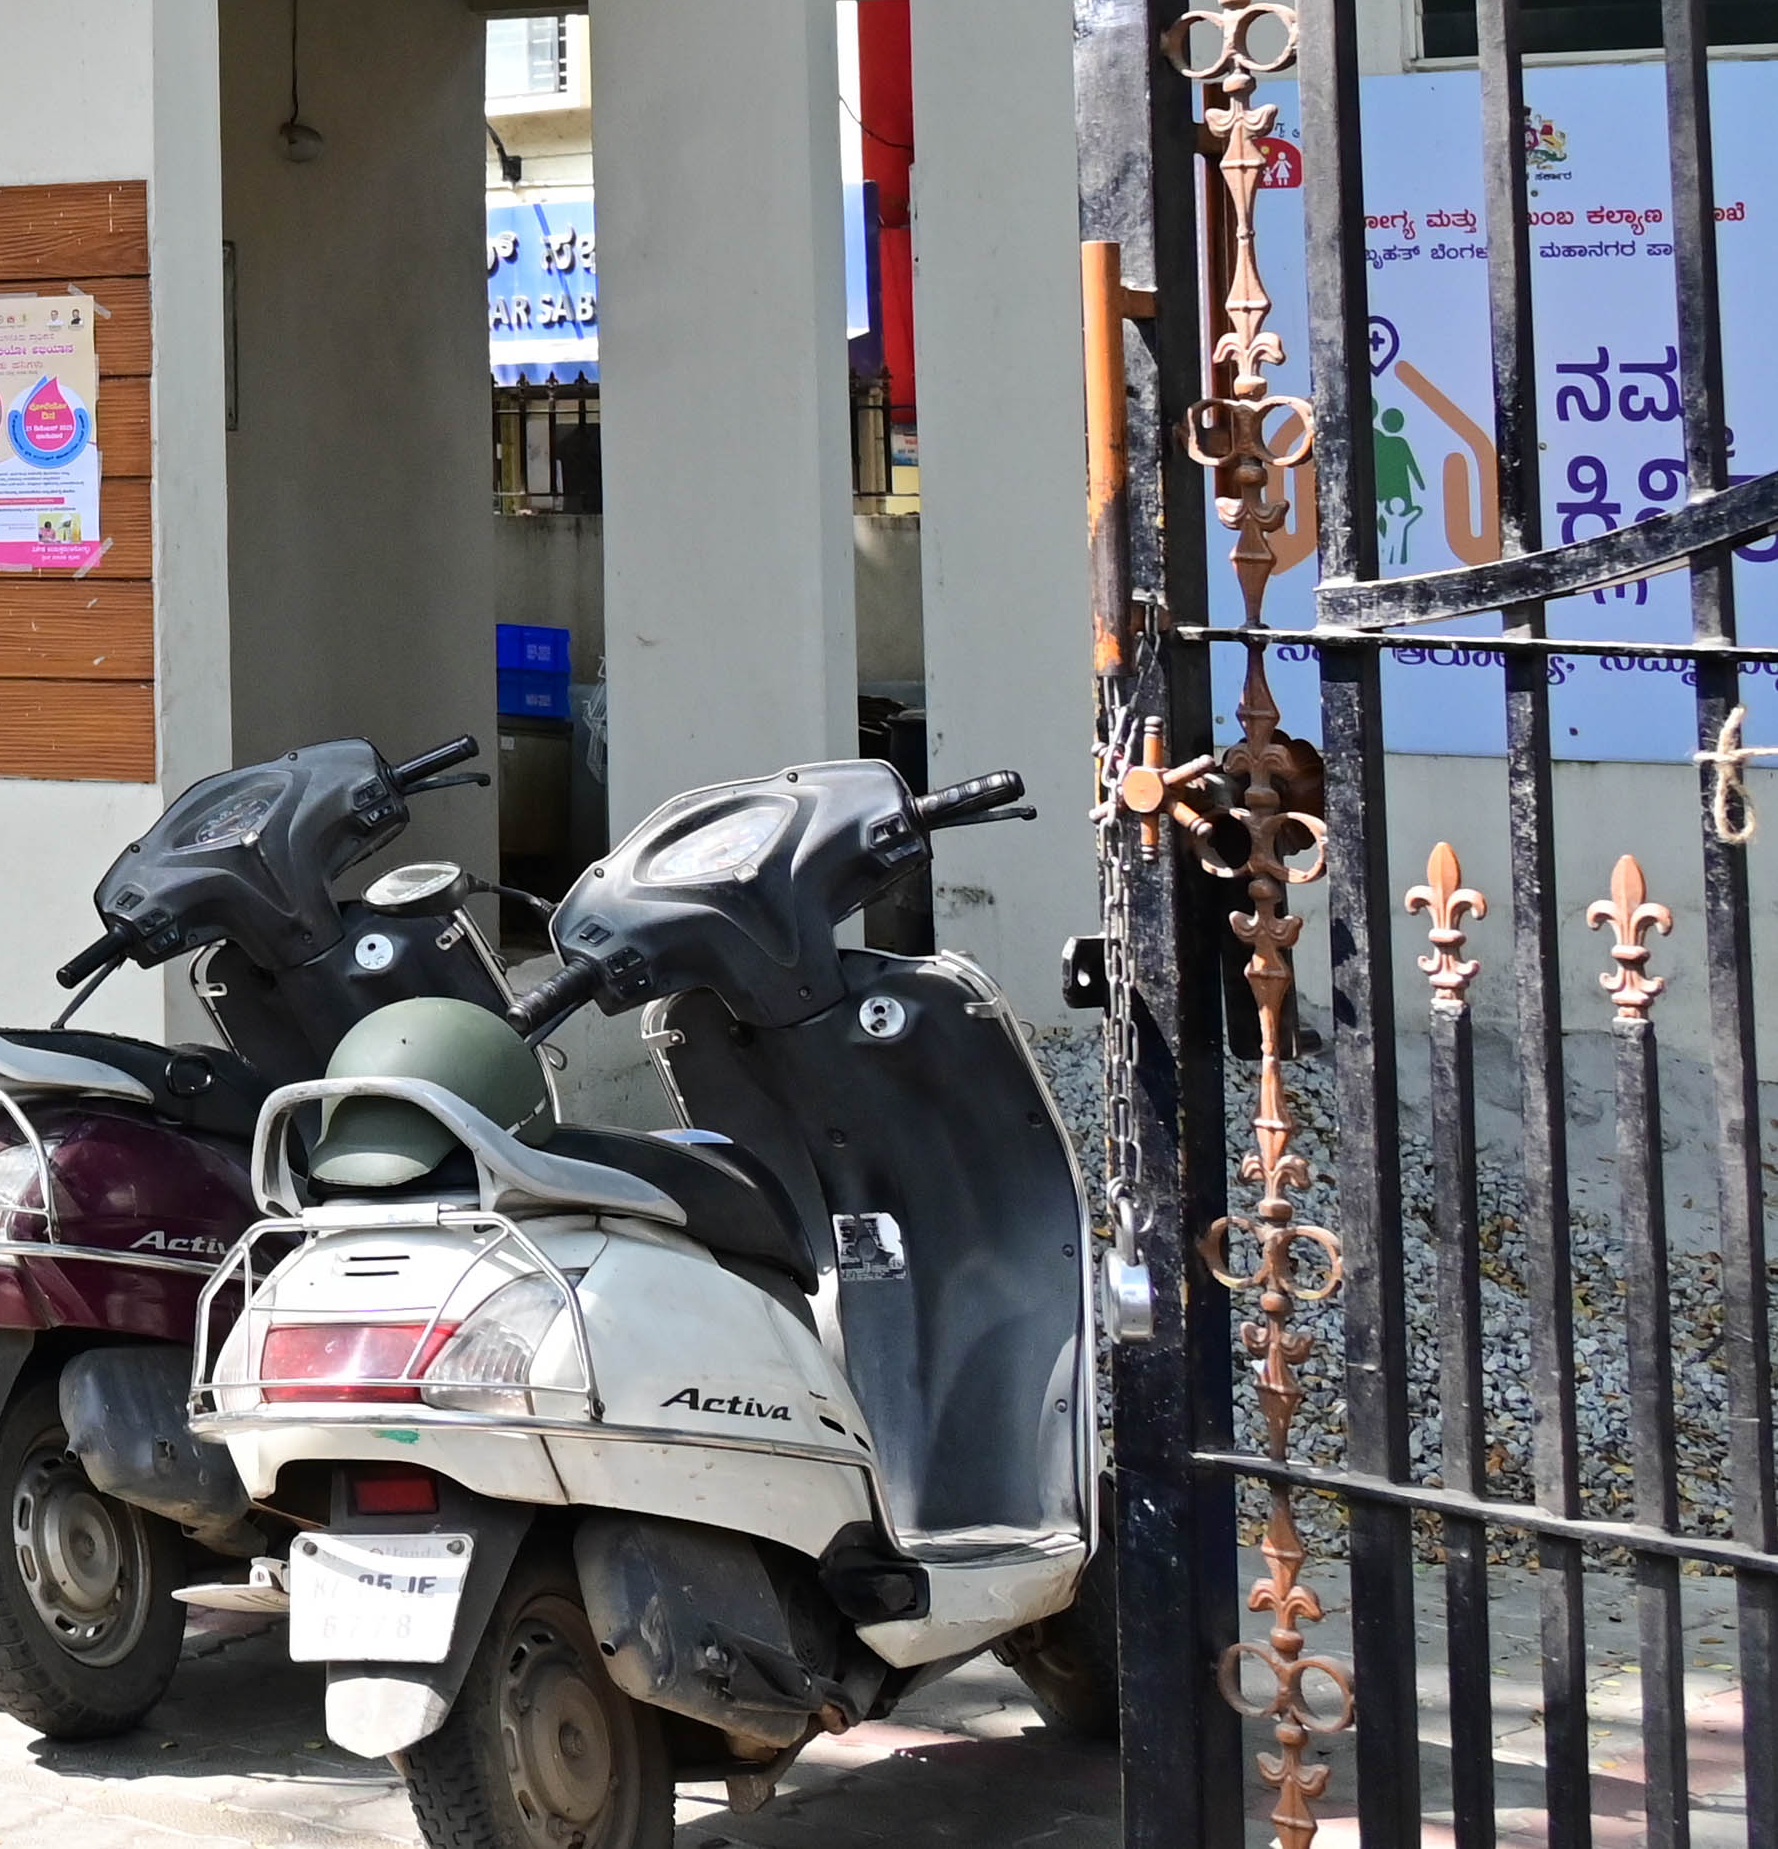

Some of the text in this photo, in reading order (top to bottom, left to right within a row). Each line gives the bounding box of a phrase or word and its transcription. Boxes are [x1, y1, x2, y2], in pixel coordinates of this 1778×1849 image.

[1426, 206, 1664, 237] ಮತ್ತು ಕಲ್ಯಾಣ
[1539, 241, 1637, 260] ಮಹಾನಗರ
[489, 292, 597, 326] AR SAB
[130, 1230, 228, 1255] Activ
[659, 1387, 792, 1421] Activa
